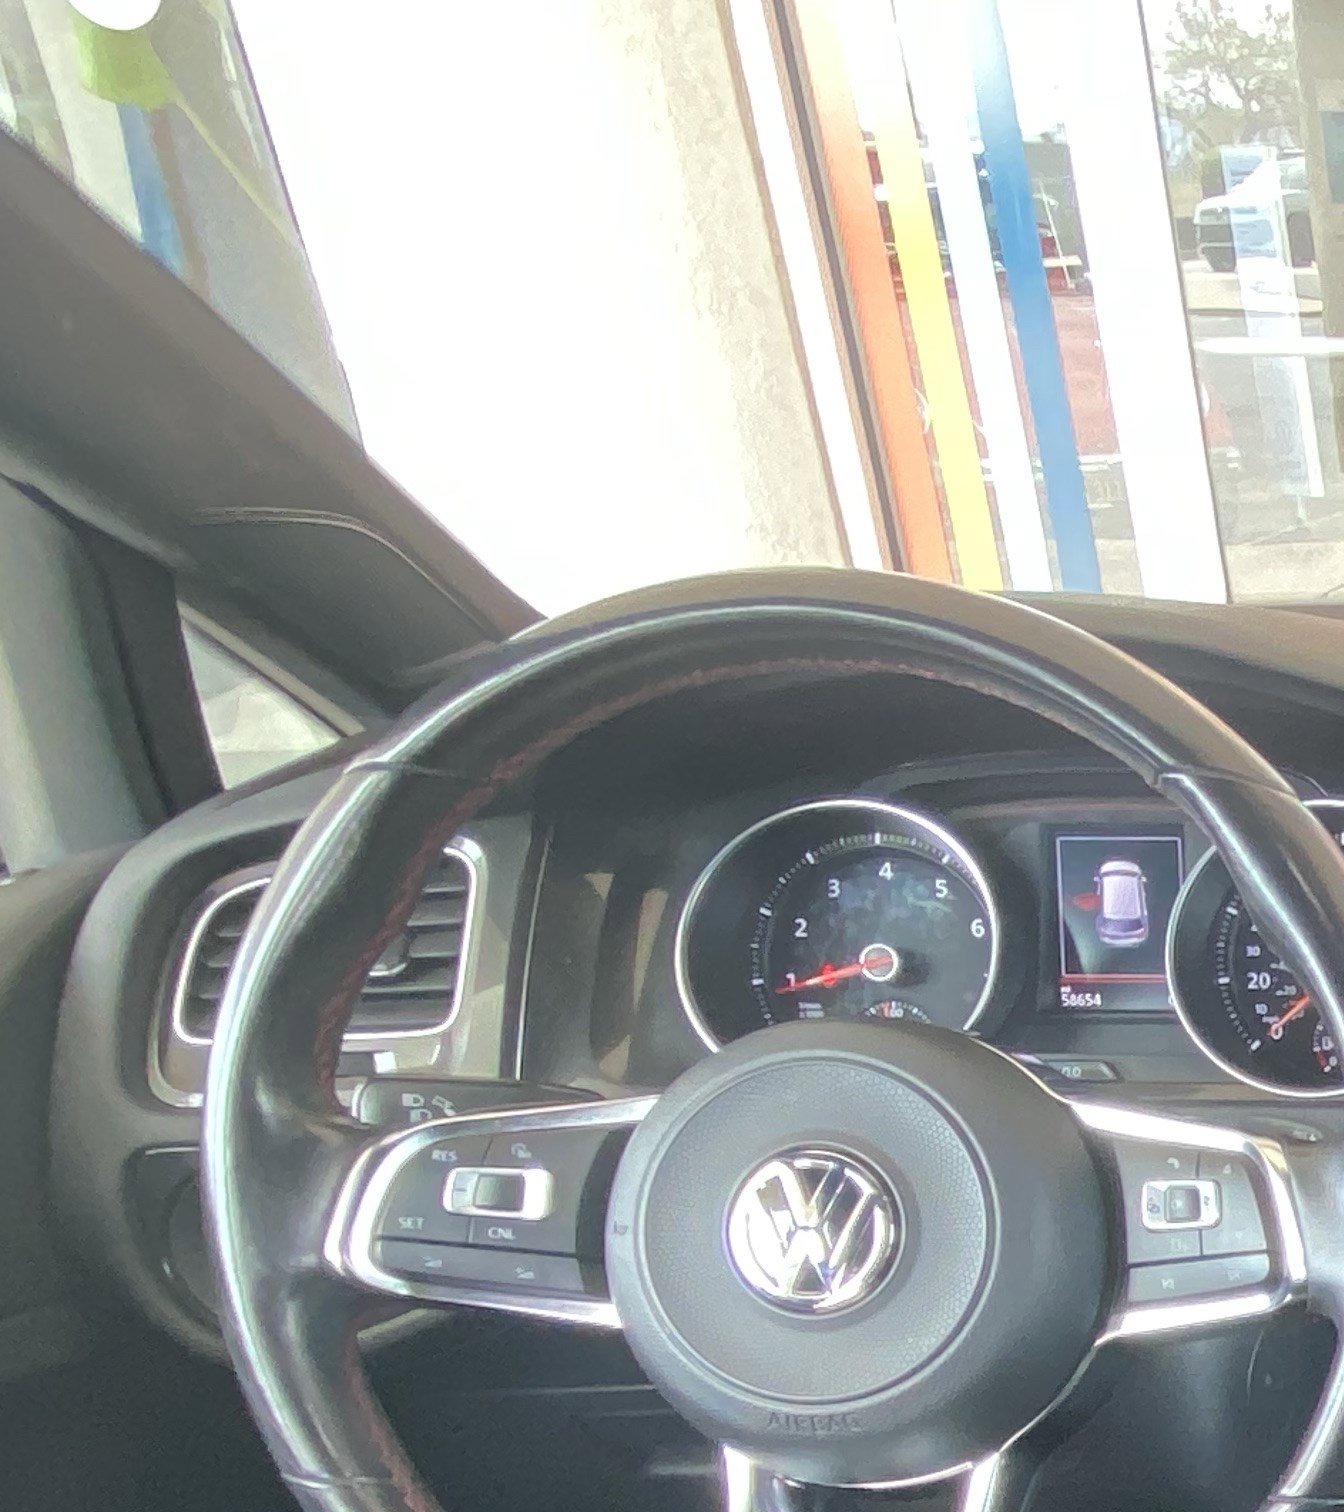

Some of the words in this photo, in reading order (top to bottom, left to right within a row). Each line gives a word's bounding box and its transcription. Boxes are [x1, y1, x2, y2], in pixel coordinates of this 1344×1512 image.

[879, 861, 894, 881] 4
[827, 879, 841, 898] 3
[935, 879, 949, 898] 5
[794, 917, 809, 938] 2
[970, 918, 986, 938] 6
[785, 972, 796, 991] 1
[1247, 972, 1271, 990] 20
[1270, 1023, 1283, 1040] 0
[431, 1149, 458, 1163] RES
[398, 1216, 424, 1230] SET
[487, 1227, 517, 1241] CNL
